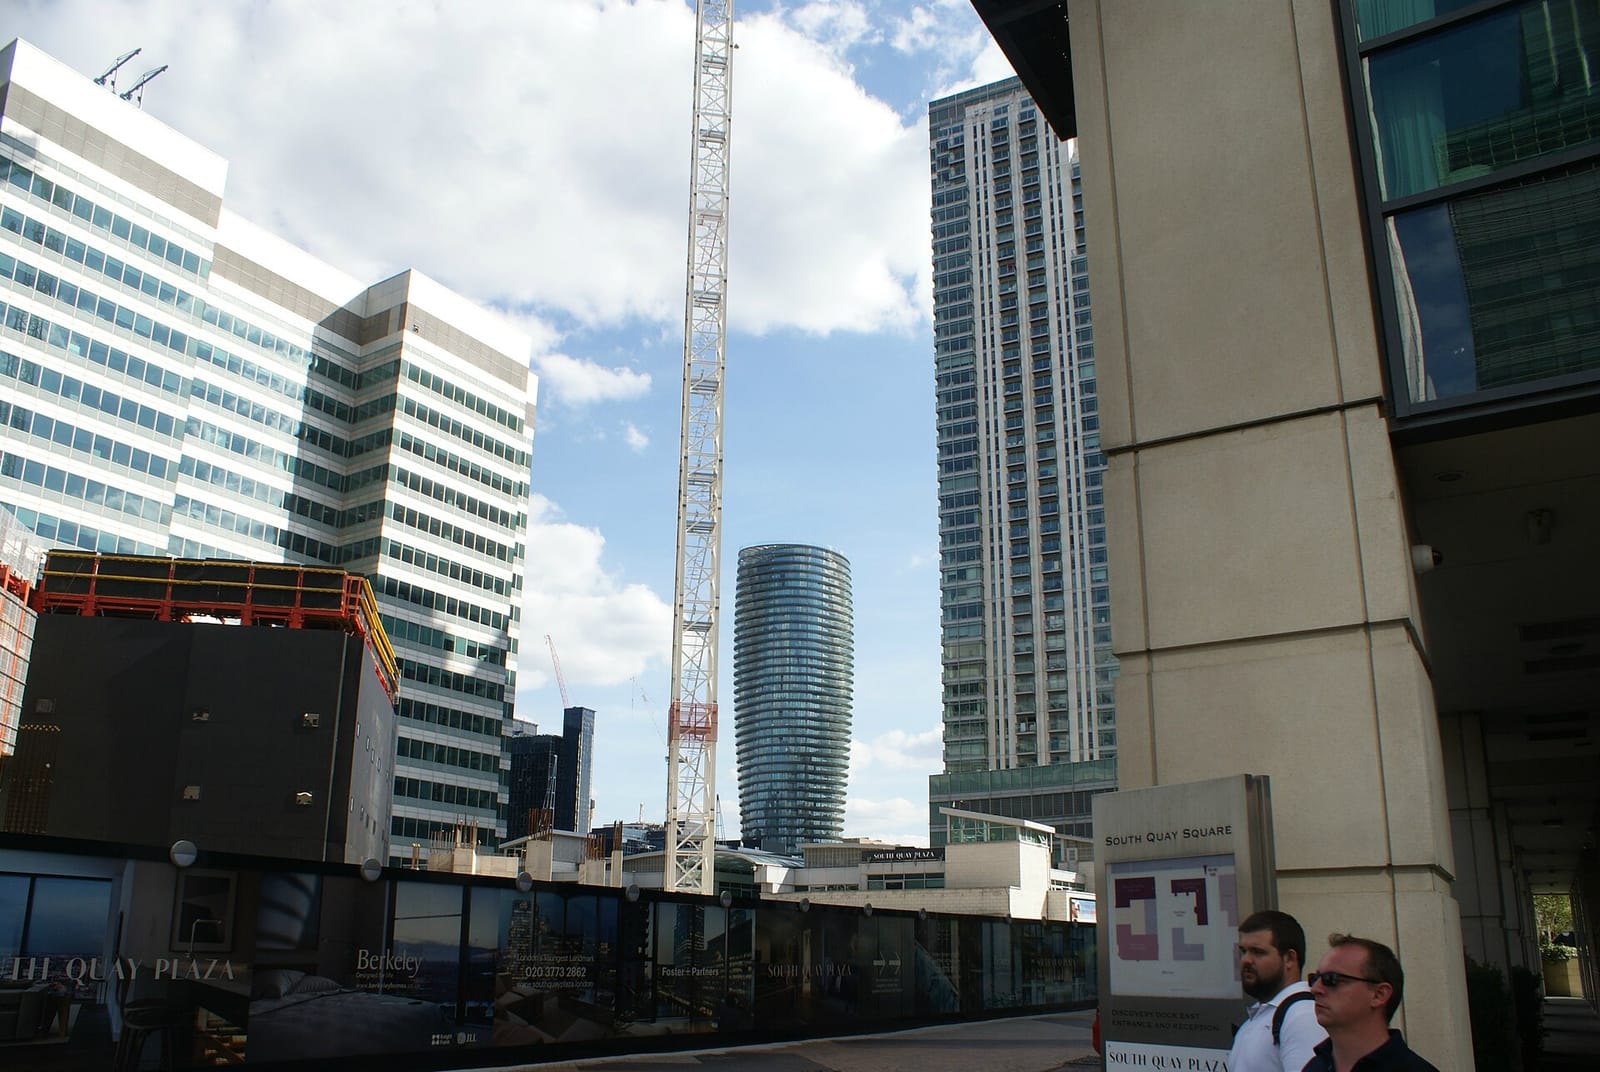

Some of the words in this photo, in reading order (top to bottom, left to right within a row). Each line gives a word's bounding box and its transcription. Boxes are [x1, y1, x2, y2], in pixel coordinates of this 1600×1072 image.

[1105, 835, 1142, 846] SOUTH
[1146, 832, 1178, 843] QUAY
[1183, 825, 1232, 839] SQUARE
[896, 851, 912, 860] QUAY
[914, 850, 935, 858] PLAZA
[65, 957, 143, 986] QUAY
[154, 958, 235, 981] PLAZA
[356, 948, 423, 978] Berkeley
[525, 966, 543, 977] 020
[545, 966, 564, 977] 3773
[566, 966, 587, 977] 2862
[662, 966, 684, 976] Foster
[691, 966, 720, 976] Partners
[1109, 1052, 1147, 1065] SOUTH
[1152, 1055, 1182, 1070] QUAY
[1188, 1058, 1229, 1072] PLAZA
